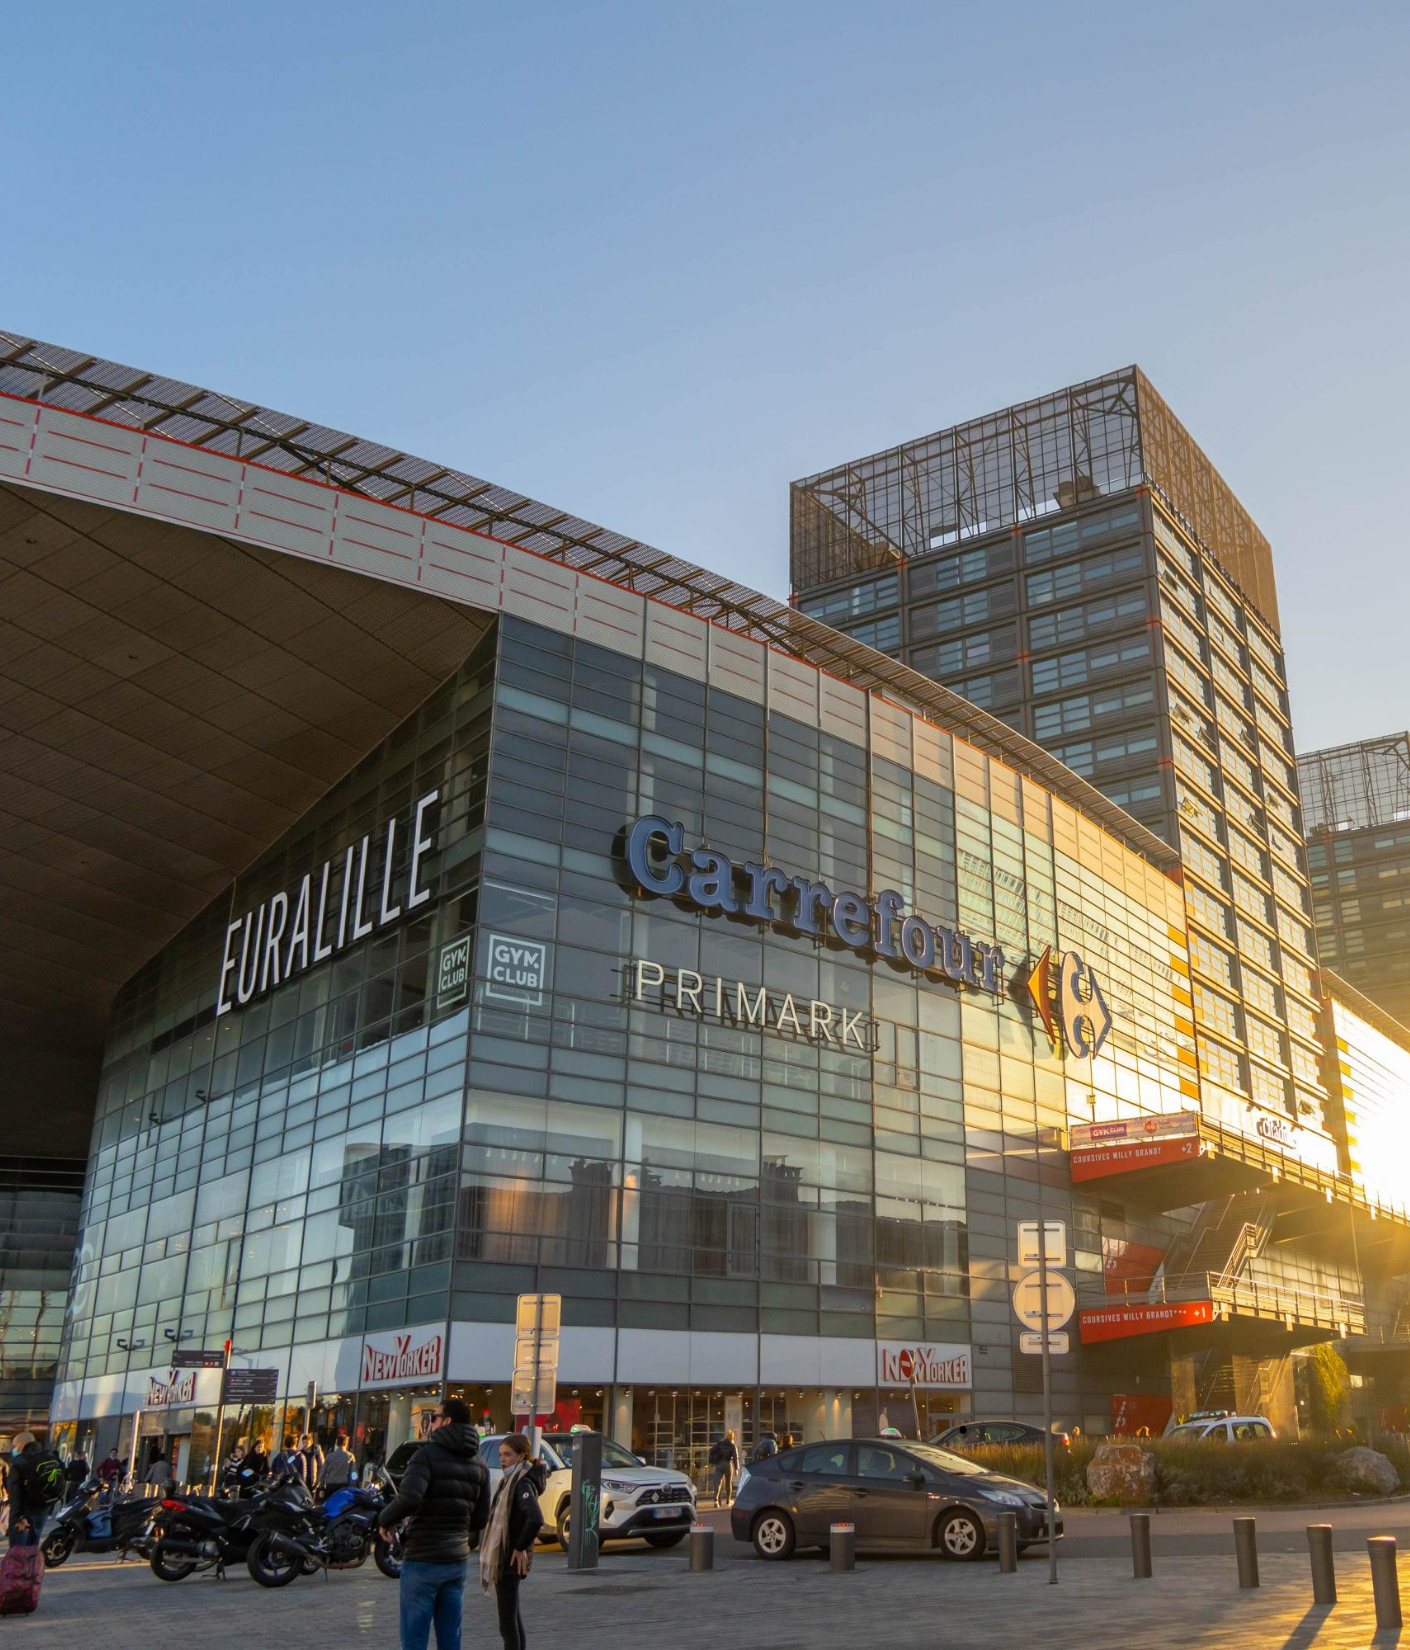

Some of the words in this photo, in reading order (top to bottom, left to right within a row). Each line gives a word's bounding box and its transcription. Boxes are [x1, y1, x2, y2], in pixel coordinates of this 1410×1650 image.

[216, 789, 438, 1017] EURALILLE
[628, 814, 1006, 993] Carrefour
[441, 967, 465, 991] CLUB
[492, 966, 539, 989] CLUB
[635, 958, 864, 1050] PRIMARK
[1073, 1152, 1110, 1164] COURSIVES
[1112, 1149, 1133, 1159] WILLY
[1135, 1147, 1162, 1157] BRANDT
[1082, 1313, 1121, 1324] COURSIVES
[1123, 1312, 1144, 1321] WILLY
[1146, 1309, 1174, 1320] BRANDT
[364, 1343, 397, 1382] NEW
[394, 1334, 441, 1378] YORKER
[882, 1348, 927, 1382] NW
[917, 1347, 969, 1383] YORKER
